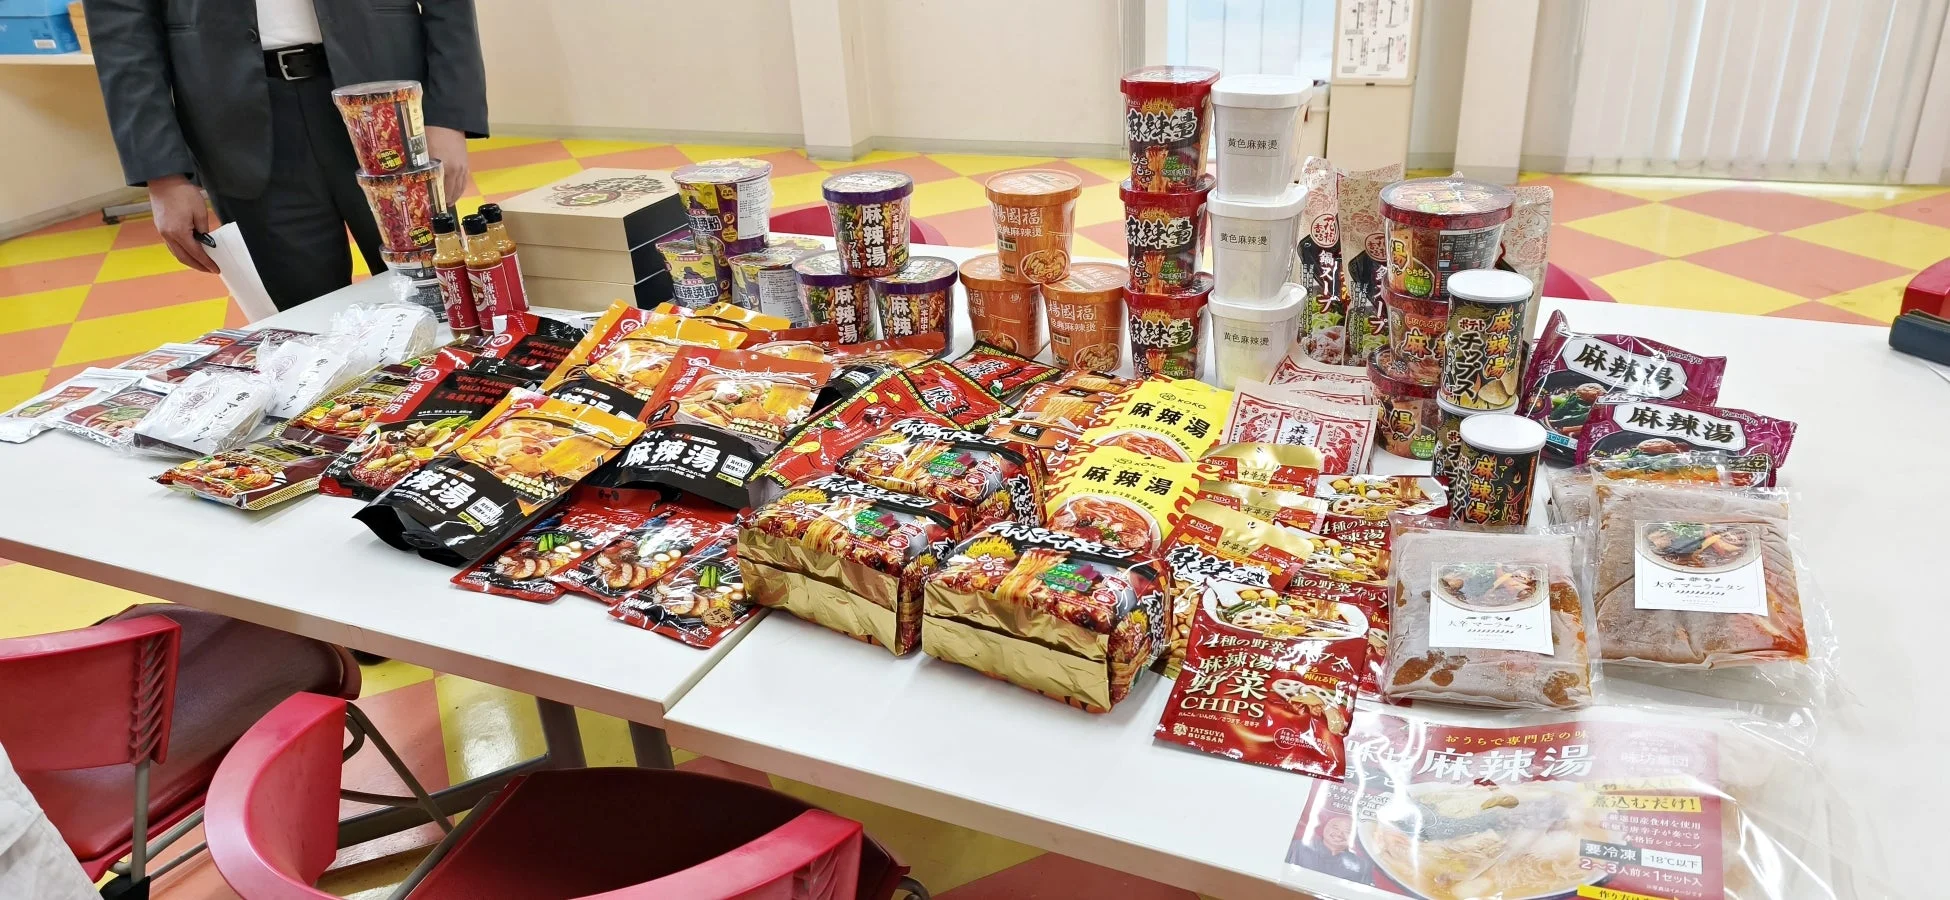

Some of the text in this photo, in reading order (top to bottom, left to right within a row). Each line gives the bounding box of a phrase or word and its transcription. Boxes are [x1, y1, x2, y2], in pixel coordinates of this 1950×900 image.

[862, 204, 887, 267] 麻辣湯
[834, 286, 859, 345] 麻辣湯
[890, 296, 914, 337] 麻辣
[1458, 318, 1486, 331] ポテト
[530, 350, 567, 361] MALATAN
[1484, 307, 1516, 380] 麻辣湯
[1452, 332, 1484, 399] チップス
[1574, 343, 1676, 392] 麻辣湯
[1128, 402, 1211, 439] 麻辣湯
[1177, 398, 1207, 410] KOKO
[1285, 424, 1309, 446] 麻辣
[1626, 405, 1736, 444] 麻辣湯
[619, 439, 721, 473] 麻辣湯
[402, 468, 477, 510] 辣湯
[1081, 466, 1174, 496] 麻辣湯
[1467, 455, 1499, 525] 麻辣湯
[1199, 653, 1277, 674] 麻辣湯
[1185, 667, 1271, 701] 野菜
[1180, 696, 1266, 718] CHIPS
[1187, 733, 1225, 744] BUSSAN
[1189, 726, 1226, 739] TATSUYA
[1445, 729, 1590, 746] おうちで専門店の味
[1416, 743, 1596, 784] 麻辣湯
[1584, 842, 1637, 861] 要冷凍
